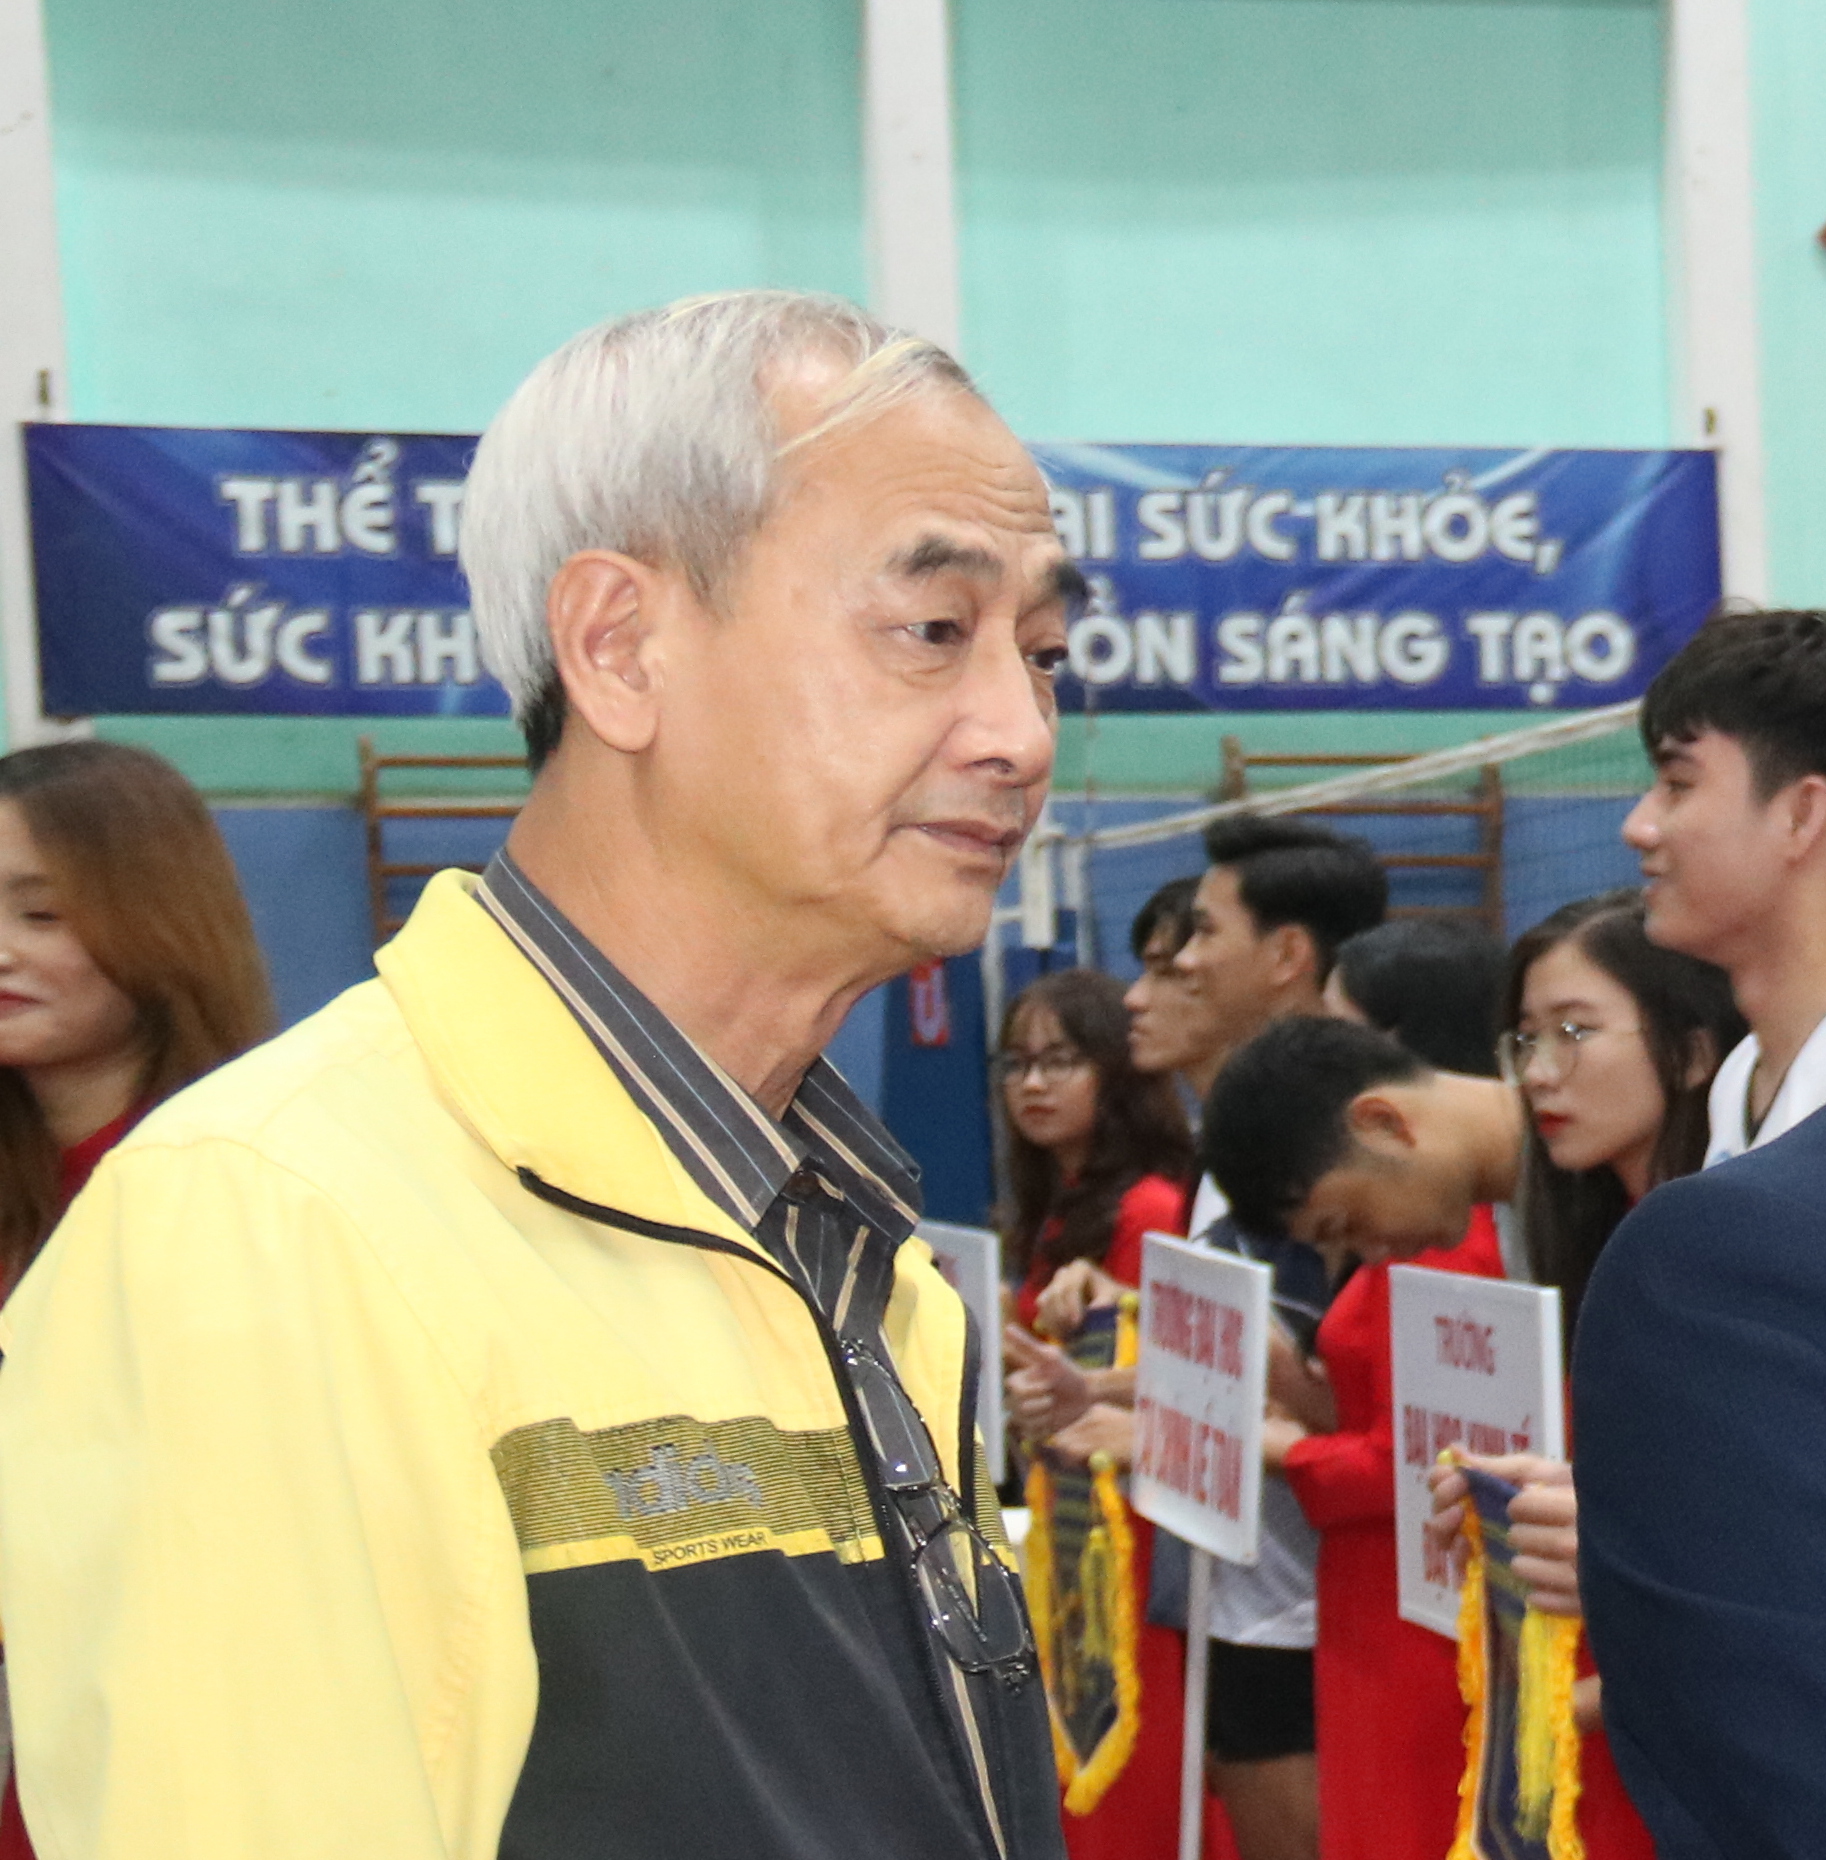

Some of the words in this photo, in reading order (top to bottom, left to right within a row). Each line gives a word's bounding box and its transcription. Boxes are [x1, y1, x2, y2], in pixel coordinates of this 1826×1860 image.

[219, 438, 398, 553] THỂ
[1137, 468, 1296, 562] SỨC
[1316, 468, 1563, 574] KHỎE,
[151, 585, 332, 684] SỨC
[355, 608, 480, 685] KH
[1217, 591, 1450, 683] SÁNG
[1466, 611, 1634, 704] TẠO
[652, 1539, 718, 1566] SPORTS
[721, 1531, 768, 1552] WEAR
